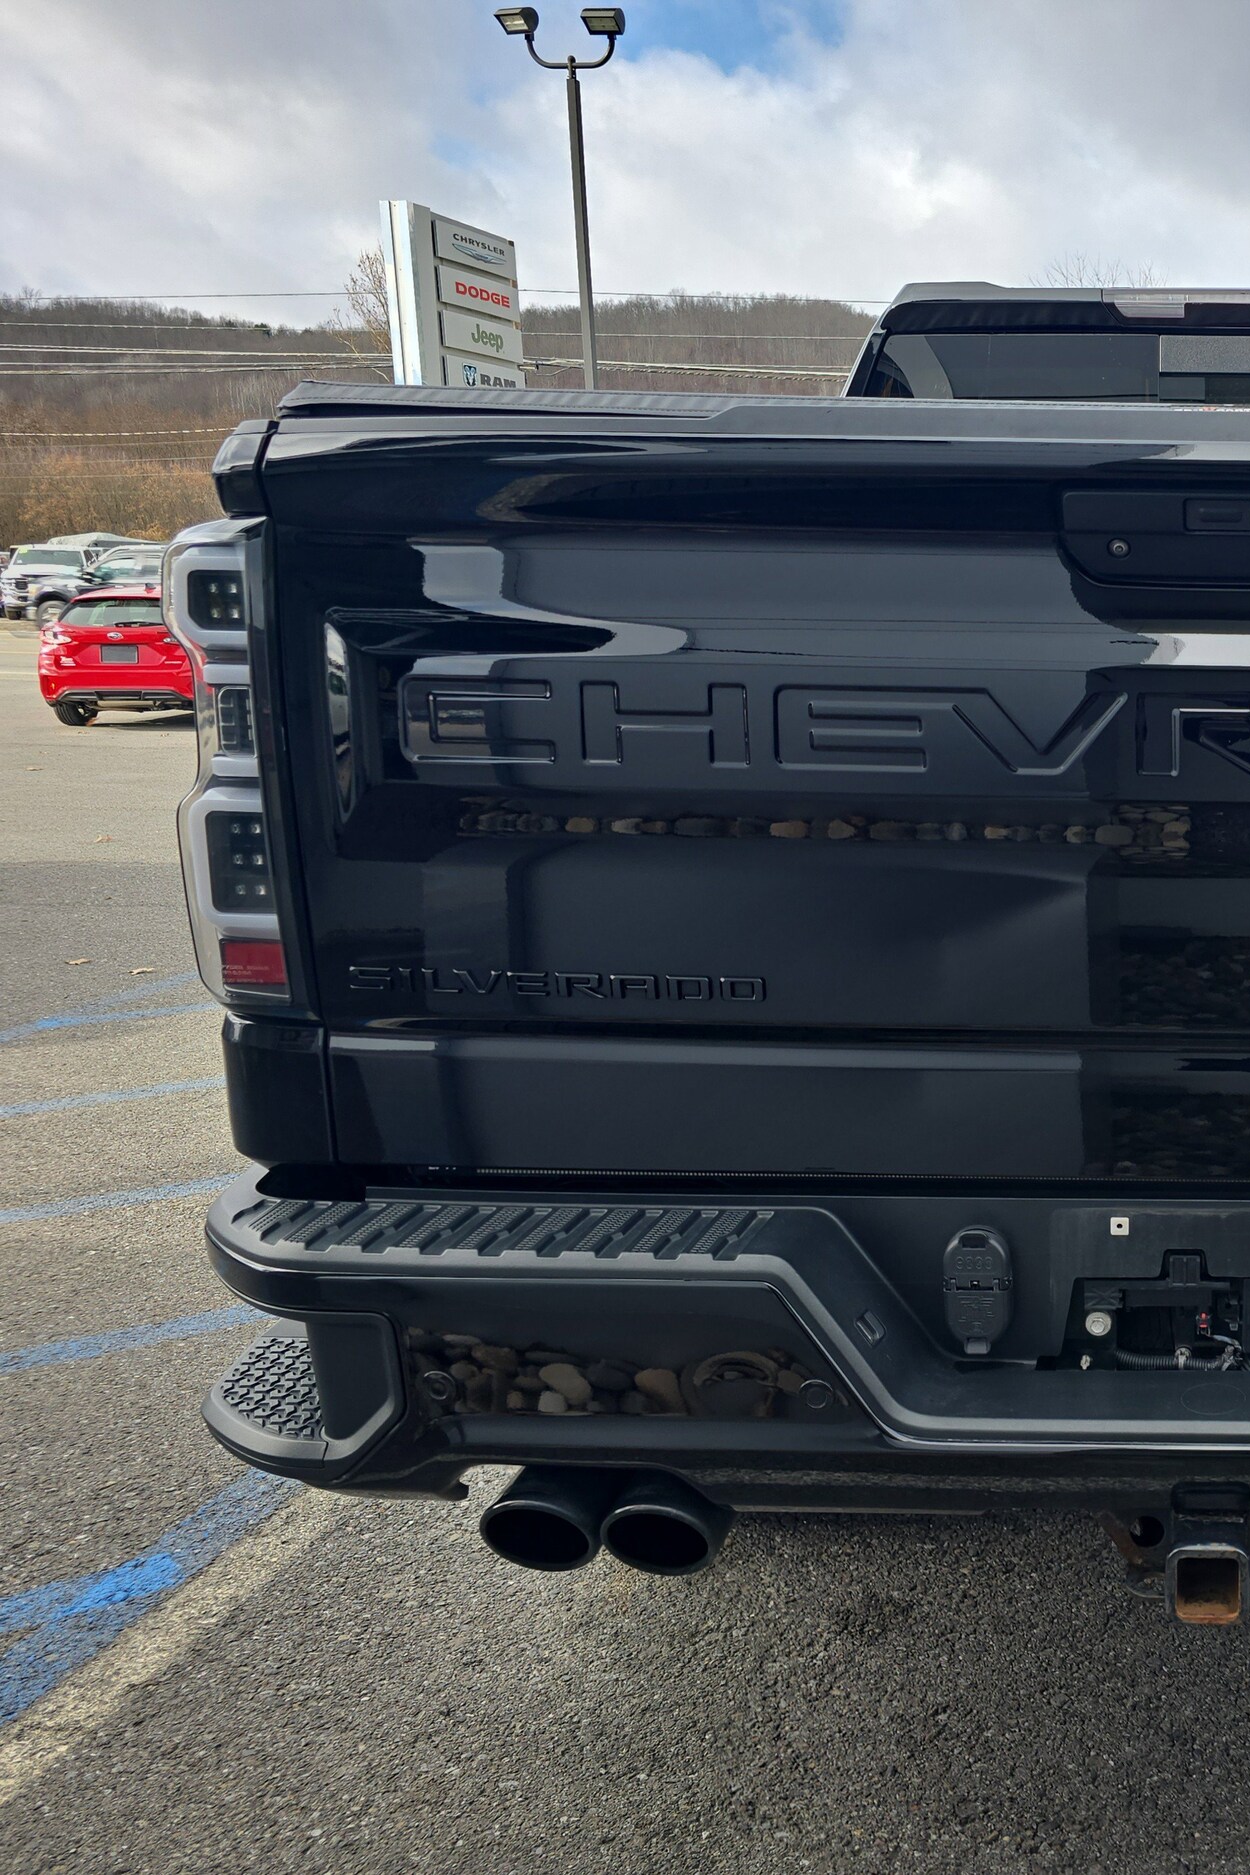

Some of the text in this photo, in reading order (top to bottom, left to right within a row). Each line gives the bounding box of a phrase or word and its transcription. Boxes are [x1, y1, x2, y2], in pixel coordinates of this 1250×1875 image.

[452, 233, 506, 256] CHRYSLER
[455, 281, 511, 308] DODGE
[471, 323, 504, 353] Jeep
[480, 373, 517, 388] RAM
[348, 966, 767, 1001] SILVERADO
